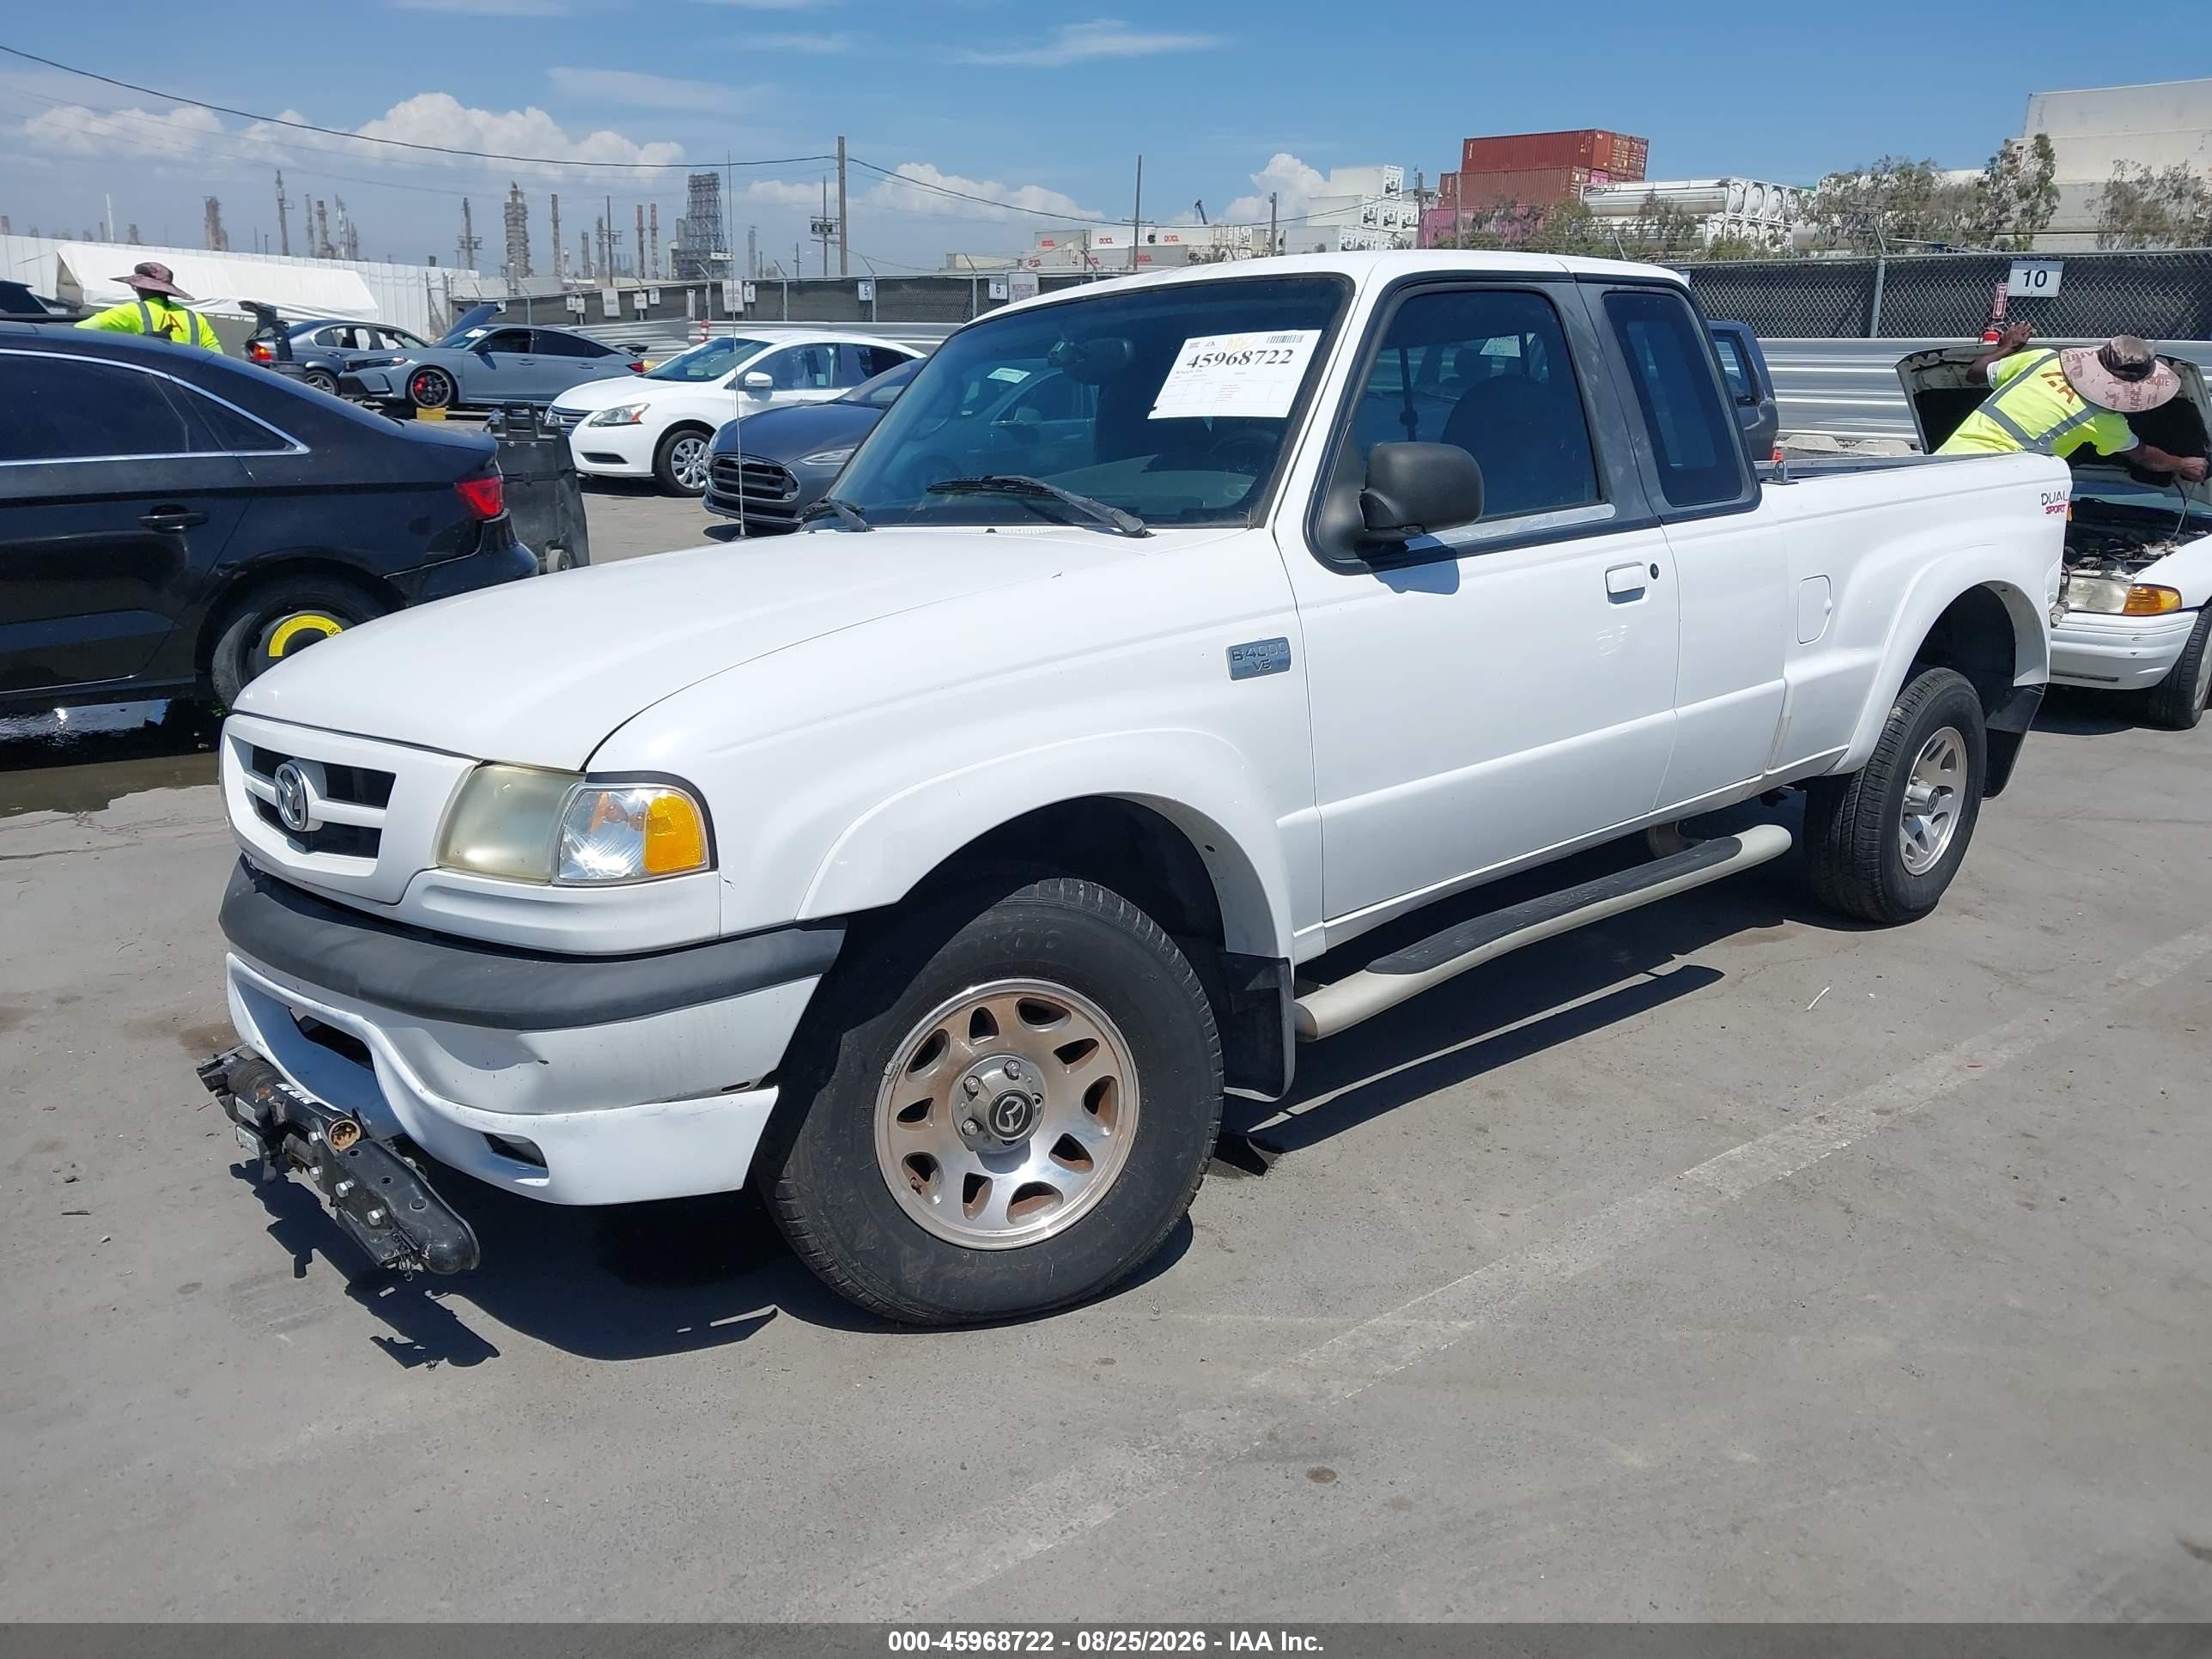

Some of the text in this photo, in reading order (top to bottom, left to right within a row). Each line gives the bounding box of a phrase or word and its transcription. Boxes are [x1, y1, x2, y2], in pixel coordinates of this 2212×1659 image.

[2023, 269, 2048, 288] 10
[995, 283, 1001, 295] 6
[1186, 349, 1294, 369] 45968722
[2040, 489, 2069, 507] DUAL
[2045, 503, 2067, 515] SPORT
[1252, 659, 1272, 672] V6
